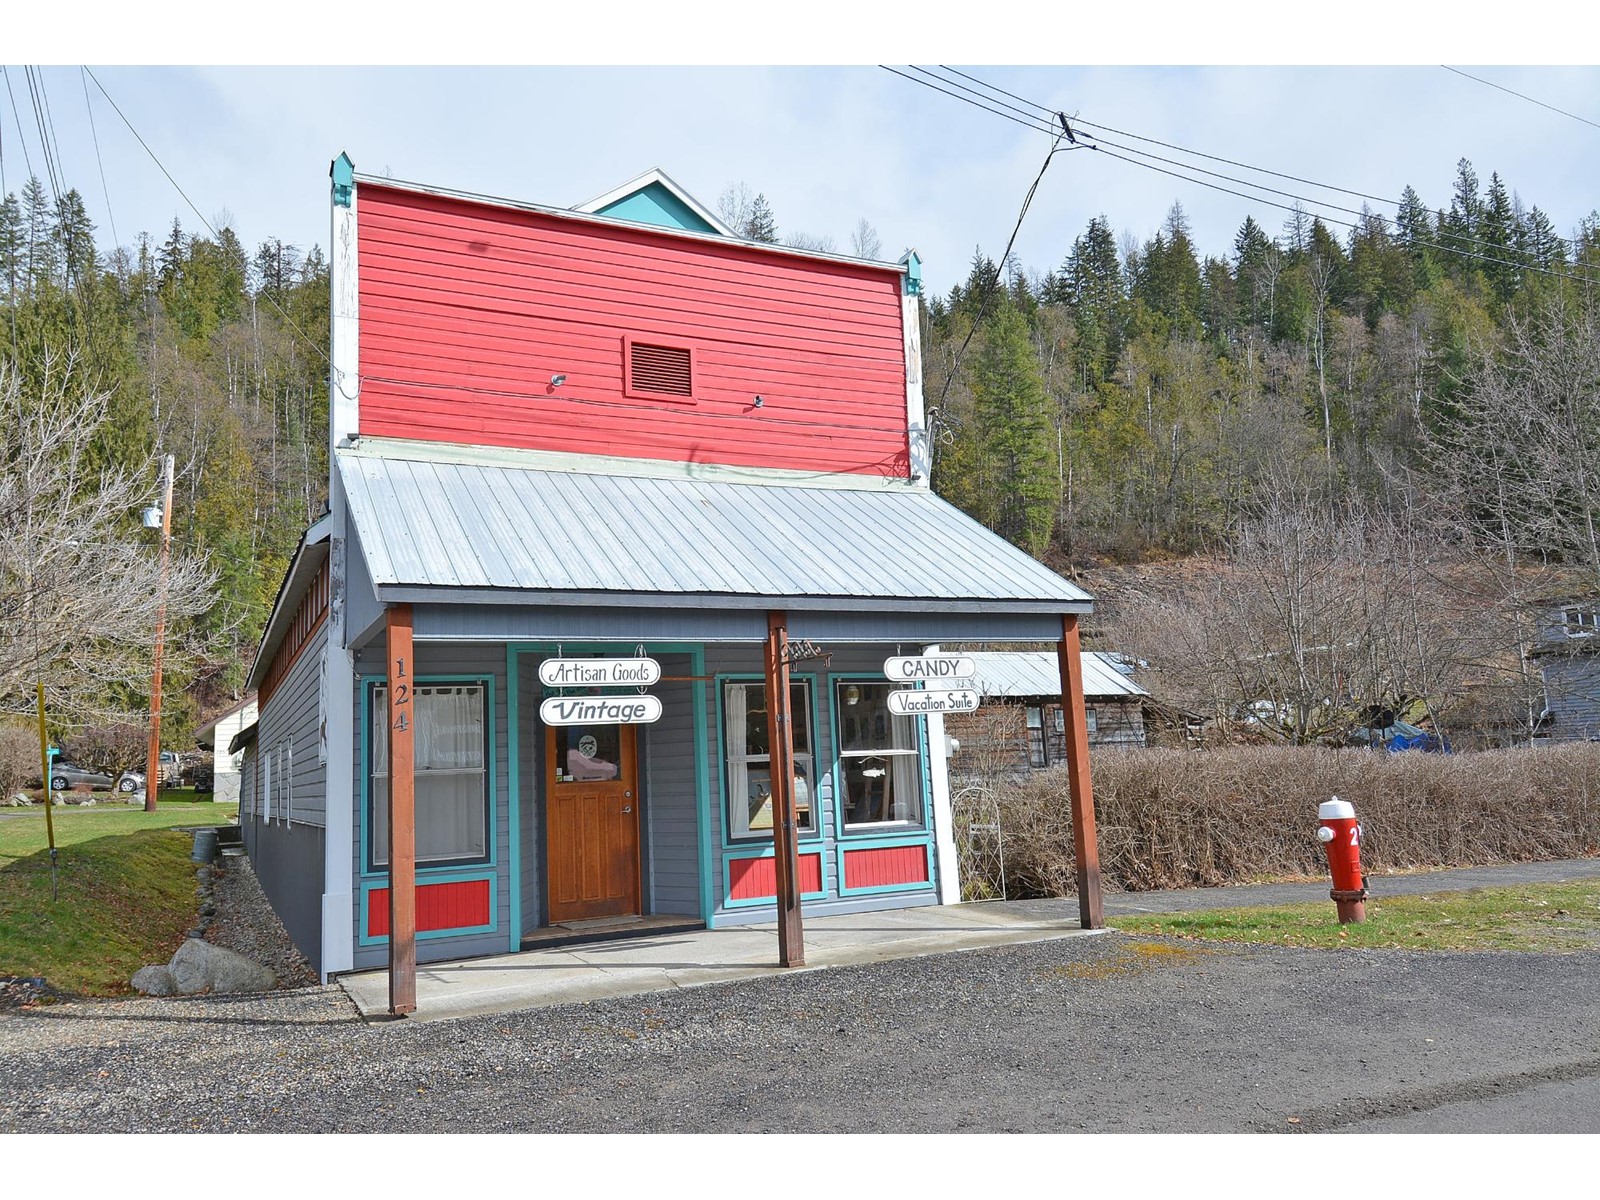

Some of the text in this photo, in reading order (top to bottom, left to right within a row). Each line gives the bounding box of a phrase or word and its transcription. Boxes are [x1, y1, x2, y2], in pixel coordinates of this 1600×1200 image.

[548, 662, 650, 682] Artisan Goods
[902, 660, 960, 677] CANDY
[393, 658, 409, 732] 124
[898, 692, 973, 711] Vacation Suite
[552, 701, 646, 723] Vintage
